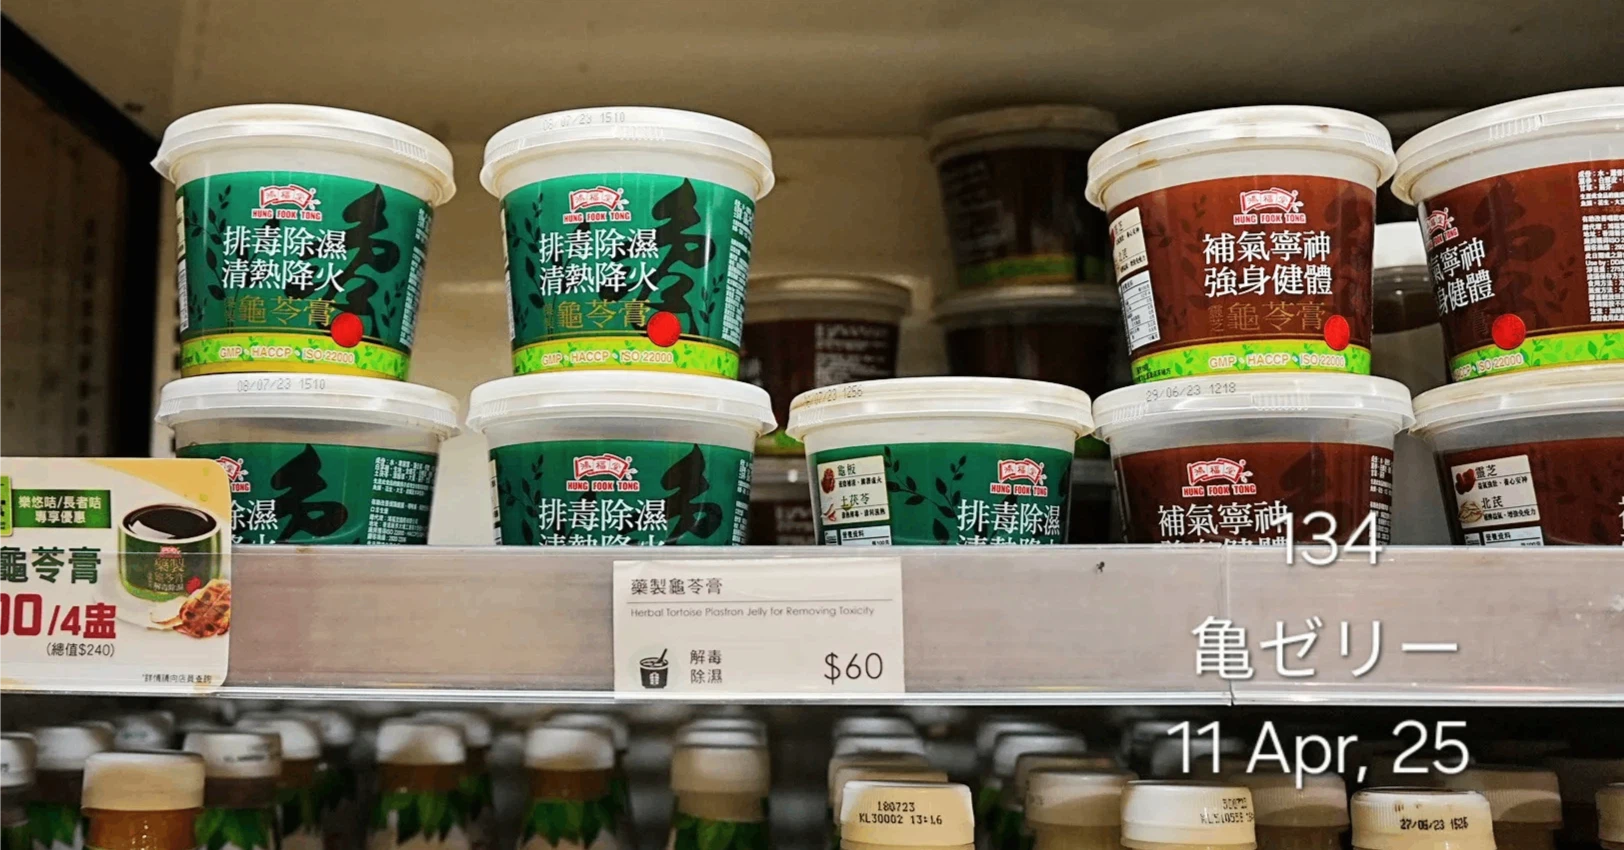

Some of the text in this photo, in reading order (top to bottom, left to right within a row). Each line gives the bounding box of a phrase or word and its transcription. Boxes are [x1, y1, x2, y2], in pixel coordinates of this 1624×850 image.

[252, 209, 322, 221] HUNG FOOK TONG
[563, 211, 630, 223] HUNG FOOK TONG
[1234, 213, 1305, 224] HUNG FOOK TONG
[223, 226, 347, 260] 排毒除濕
[539, 228, 659, 263] 排毒除濕
[1203, 230, 1331, 263] 補氣寧神
[221, 259, 345, 292] 清熱降火
[539, 262, 659, 296] 清熱降火
[1204, 264, 1333, 297] 強身健體
[558, 298, 651, 329] 龜苓膏
[1227, 301, 1326, 331] 龜苓膏
[219, 345, 355, 363] GMP HACCP ISO 22000
[542, 350, 673, 366] GMP HACCP ISO 22000
[1209, 354, 1345, 368] GMP HACCP ISO 22000
[1493, 353, 1523, 369] 22000
[300, 377, 326, 390] 1510
[1145, 382, 1236, 402] 29/06/23 1218
[231, 482, 250, 492] TONG
[567, 481, 639, 490] HUNG FOOK TONG
[991, 484, 1011, 494] HUNG
[1014, 485, 1030, 495] FOOK
[1183, 484, 1256, 496] HUNG FOOK TONG
[35, 510, 86, 523] 專享優惠
[538, 498, 668, 531] 排毒除濕
[957, 499, 1060, 536] 排毒除濕
[1157, 500, 1288, 537] 補氣寧神
[0, 546, 101, 584] 龜苓膏
[630, 577, 723, 595] 藥製龜苓膏
[631, 606, 875, 618] Herbal Tortoise Plastron Jelly for Removing Toxicity
[46, 642, 115, 657] (總值$240)
[689, 649, 723, 665] 解毒
[690, 668, 723, 684] 除濕
[824, 652, 884, 685] $60
[877, 800, 915, 812] 180723
[859, 813, 943, 825] KL30002 13:16
